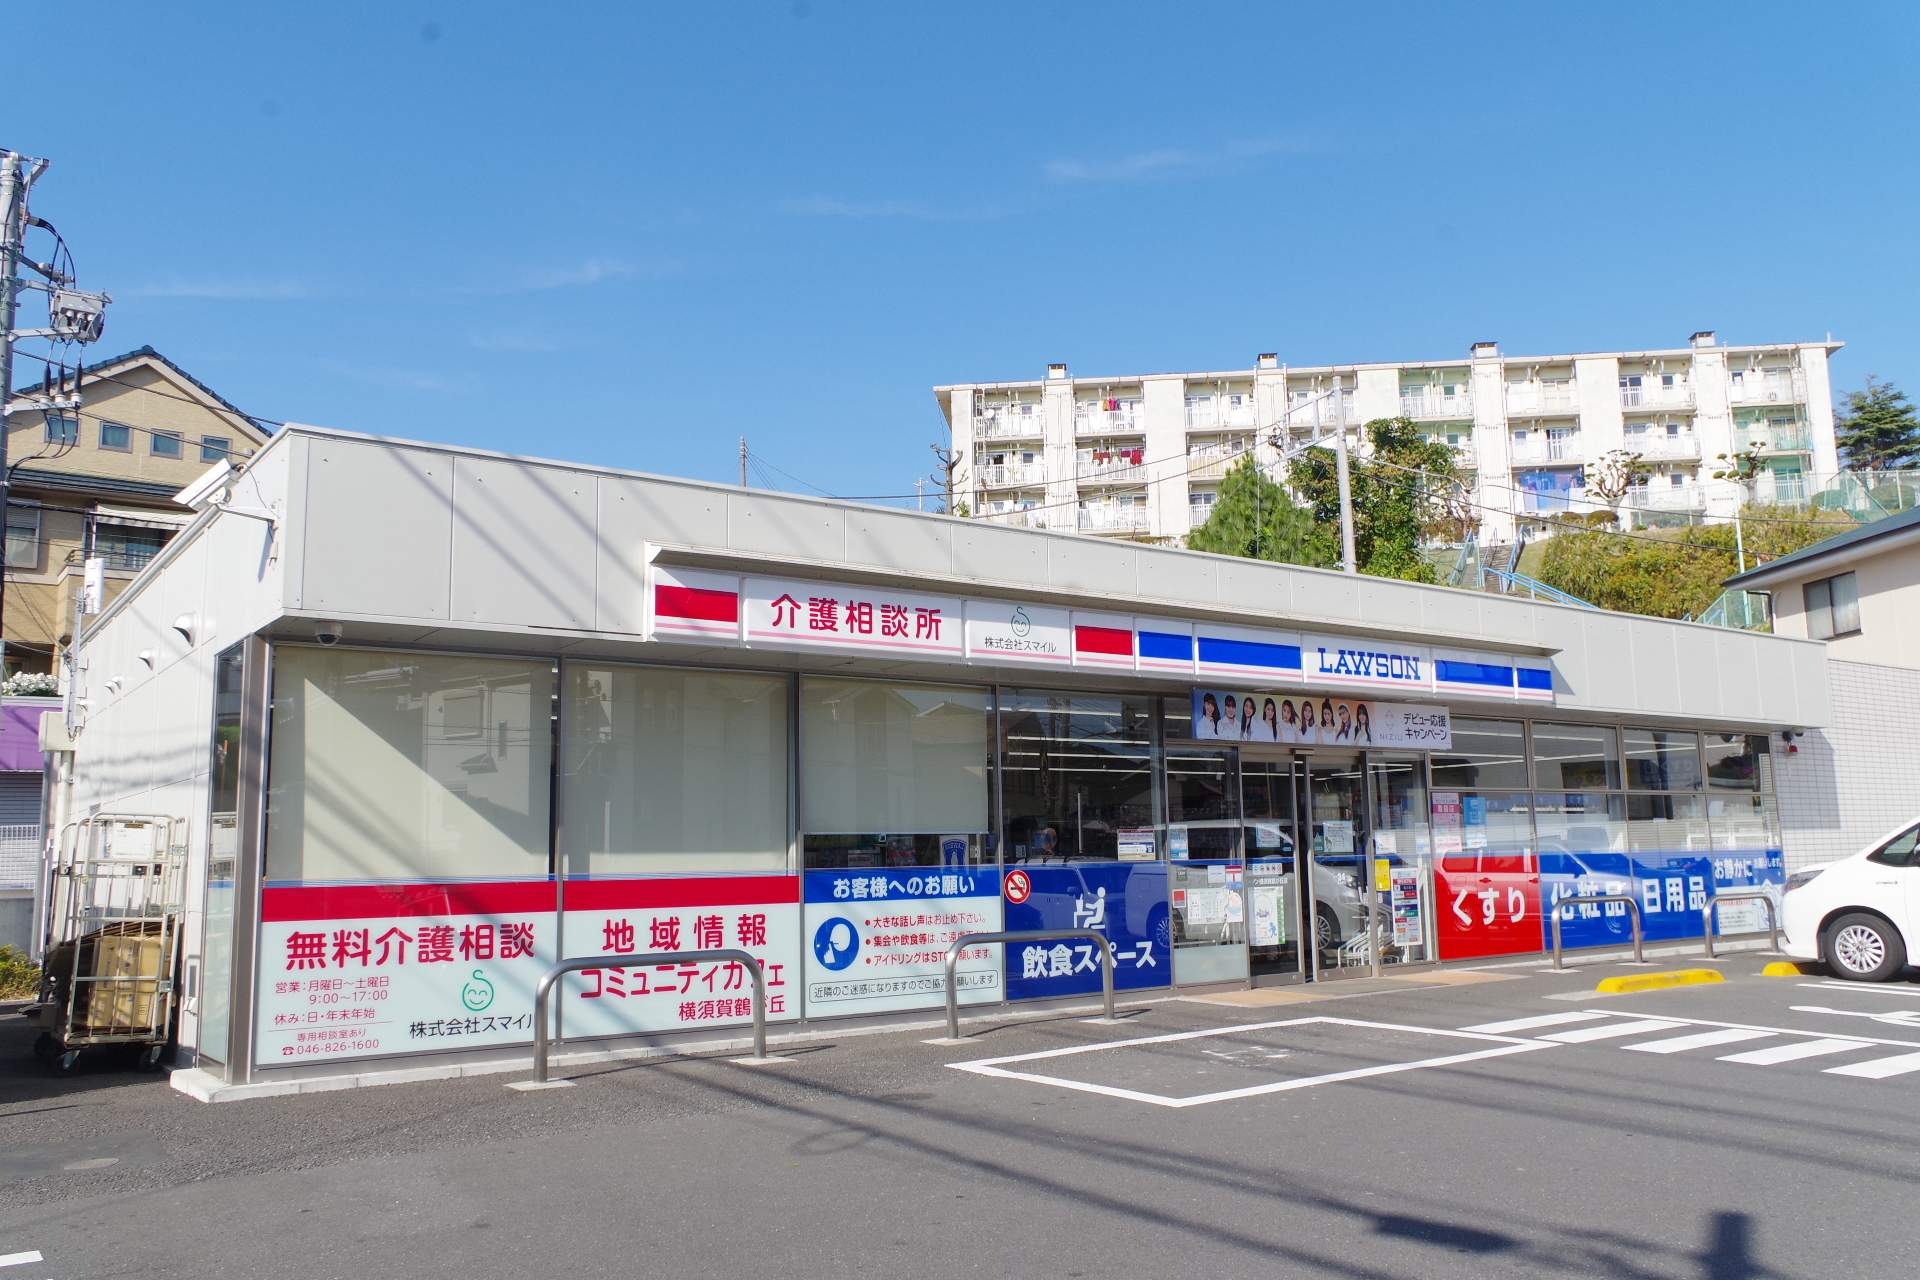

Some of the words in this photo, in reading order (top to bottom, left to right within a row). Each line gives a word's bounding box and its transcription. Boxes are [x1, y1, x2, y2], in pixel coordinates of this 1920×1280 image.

[771, 593, 942, 641] 介護相談所
[984, 636, 1057, 652] 株式会社スマイル
[1318, 648, 1420, 680] LAWSON
[1403, 712, 1447, 727] デビュー応援
[1404, 727, 1447, 740] キャンペーン
[833, 875, 975, 899] お客様へのお願い
[1642, 876, 1706, 913] 日用品
[1452, 886, 1526, 926] くすり
[602, 913, 767, 953] 地域情報
[873, 913, 986, 928] 大きな話し声はお止め下さい。
[286, 922, 535, 970] 無料介護相談
[1022, 941, 1157, 979] 飲食スペース
[679, 994, 785, 1021] 横須賀鶴丘
[297, 1029, 367, 1042] 専用相談室あり
[297, 1039, 380, 1055] 046-826-1600
